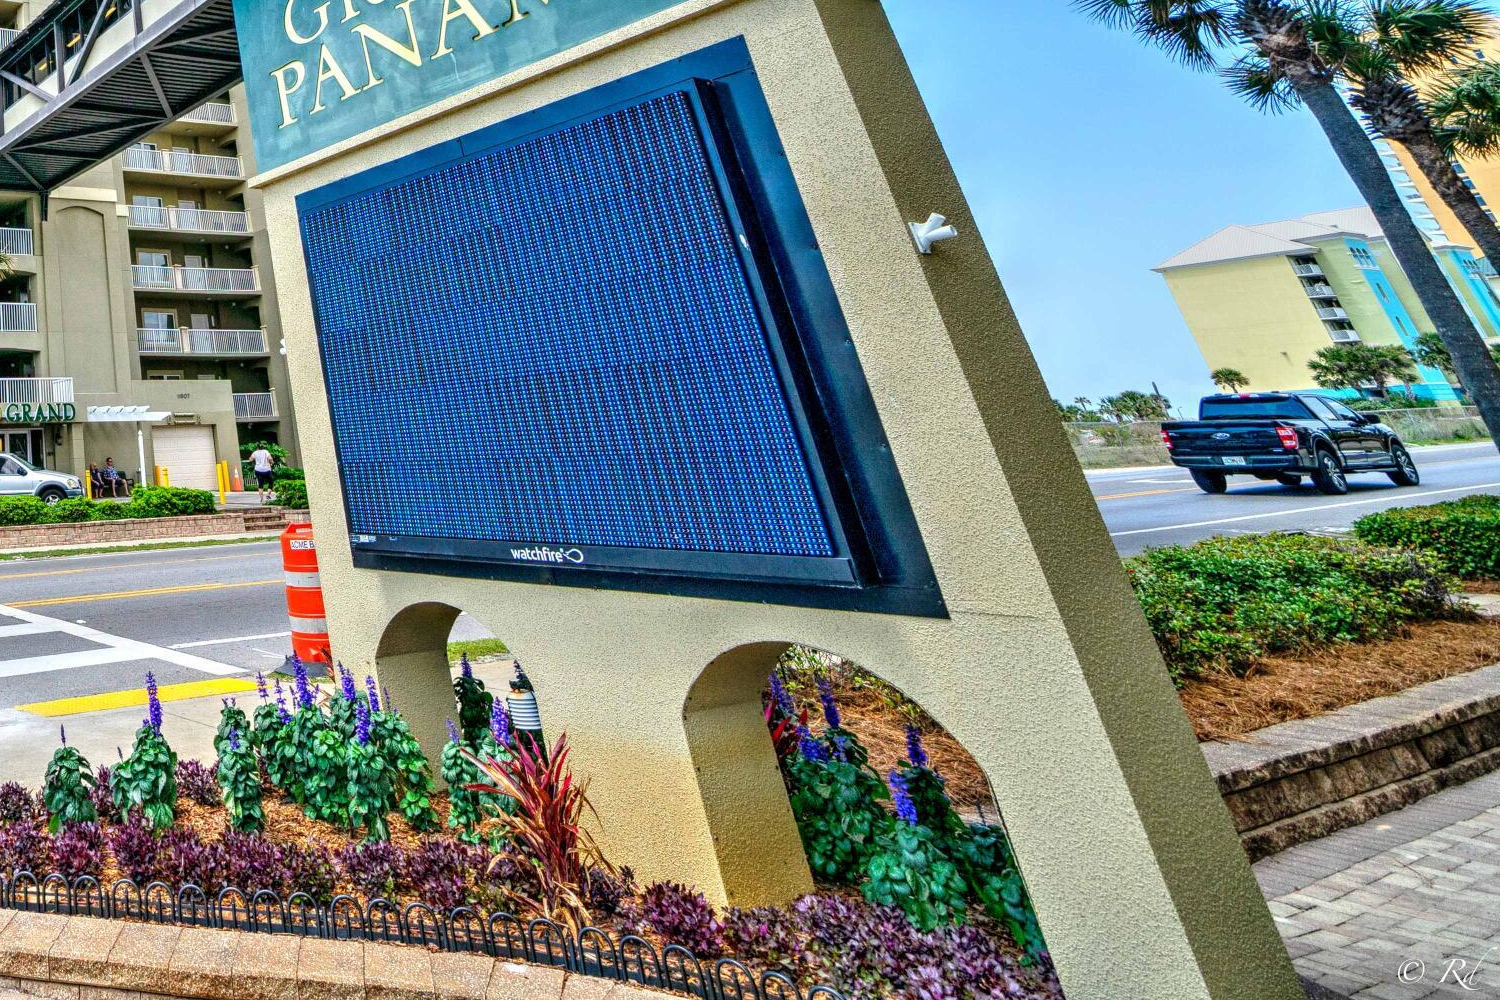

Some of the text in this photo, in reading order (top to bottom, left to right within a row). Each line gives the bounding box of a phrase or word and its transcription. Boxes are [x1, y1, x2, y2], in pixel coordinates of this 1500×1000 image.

[6, 402, 76, 422] GRAND
[291, 541, 309, 549] ACME
[510, 546, 564, 563] watchfire
